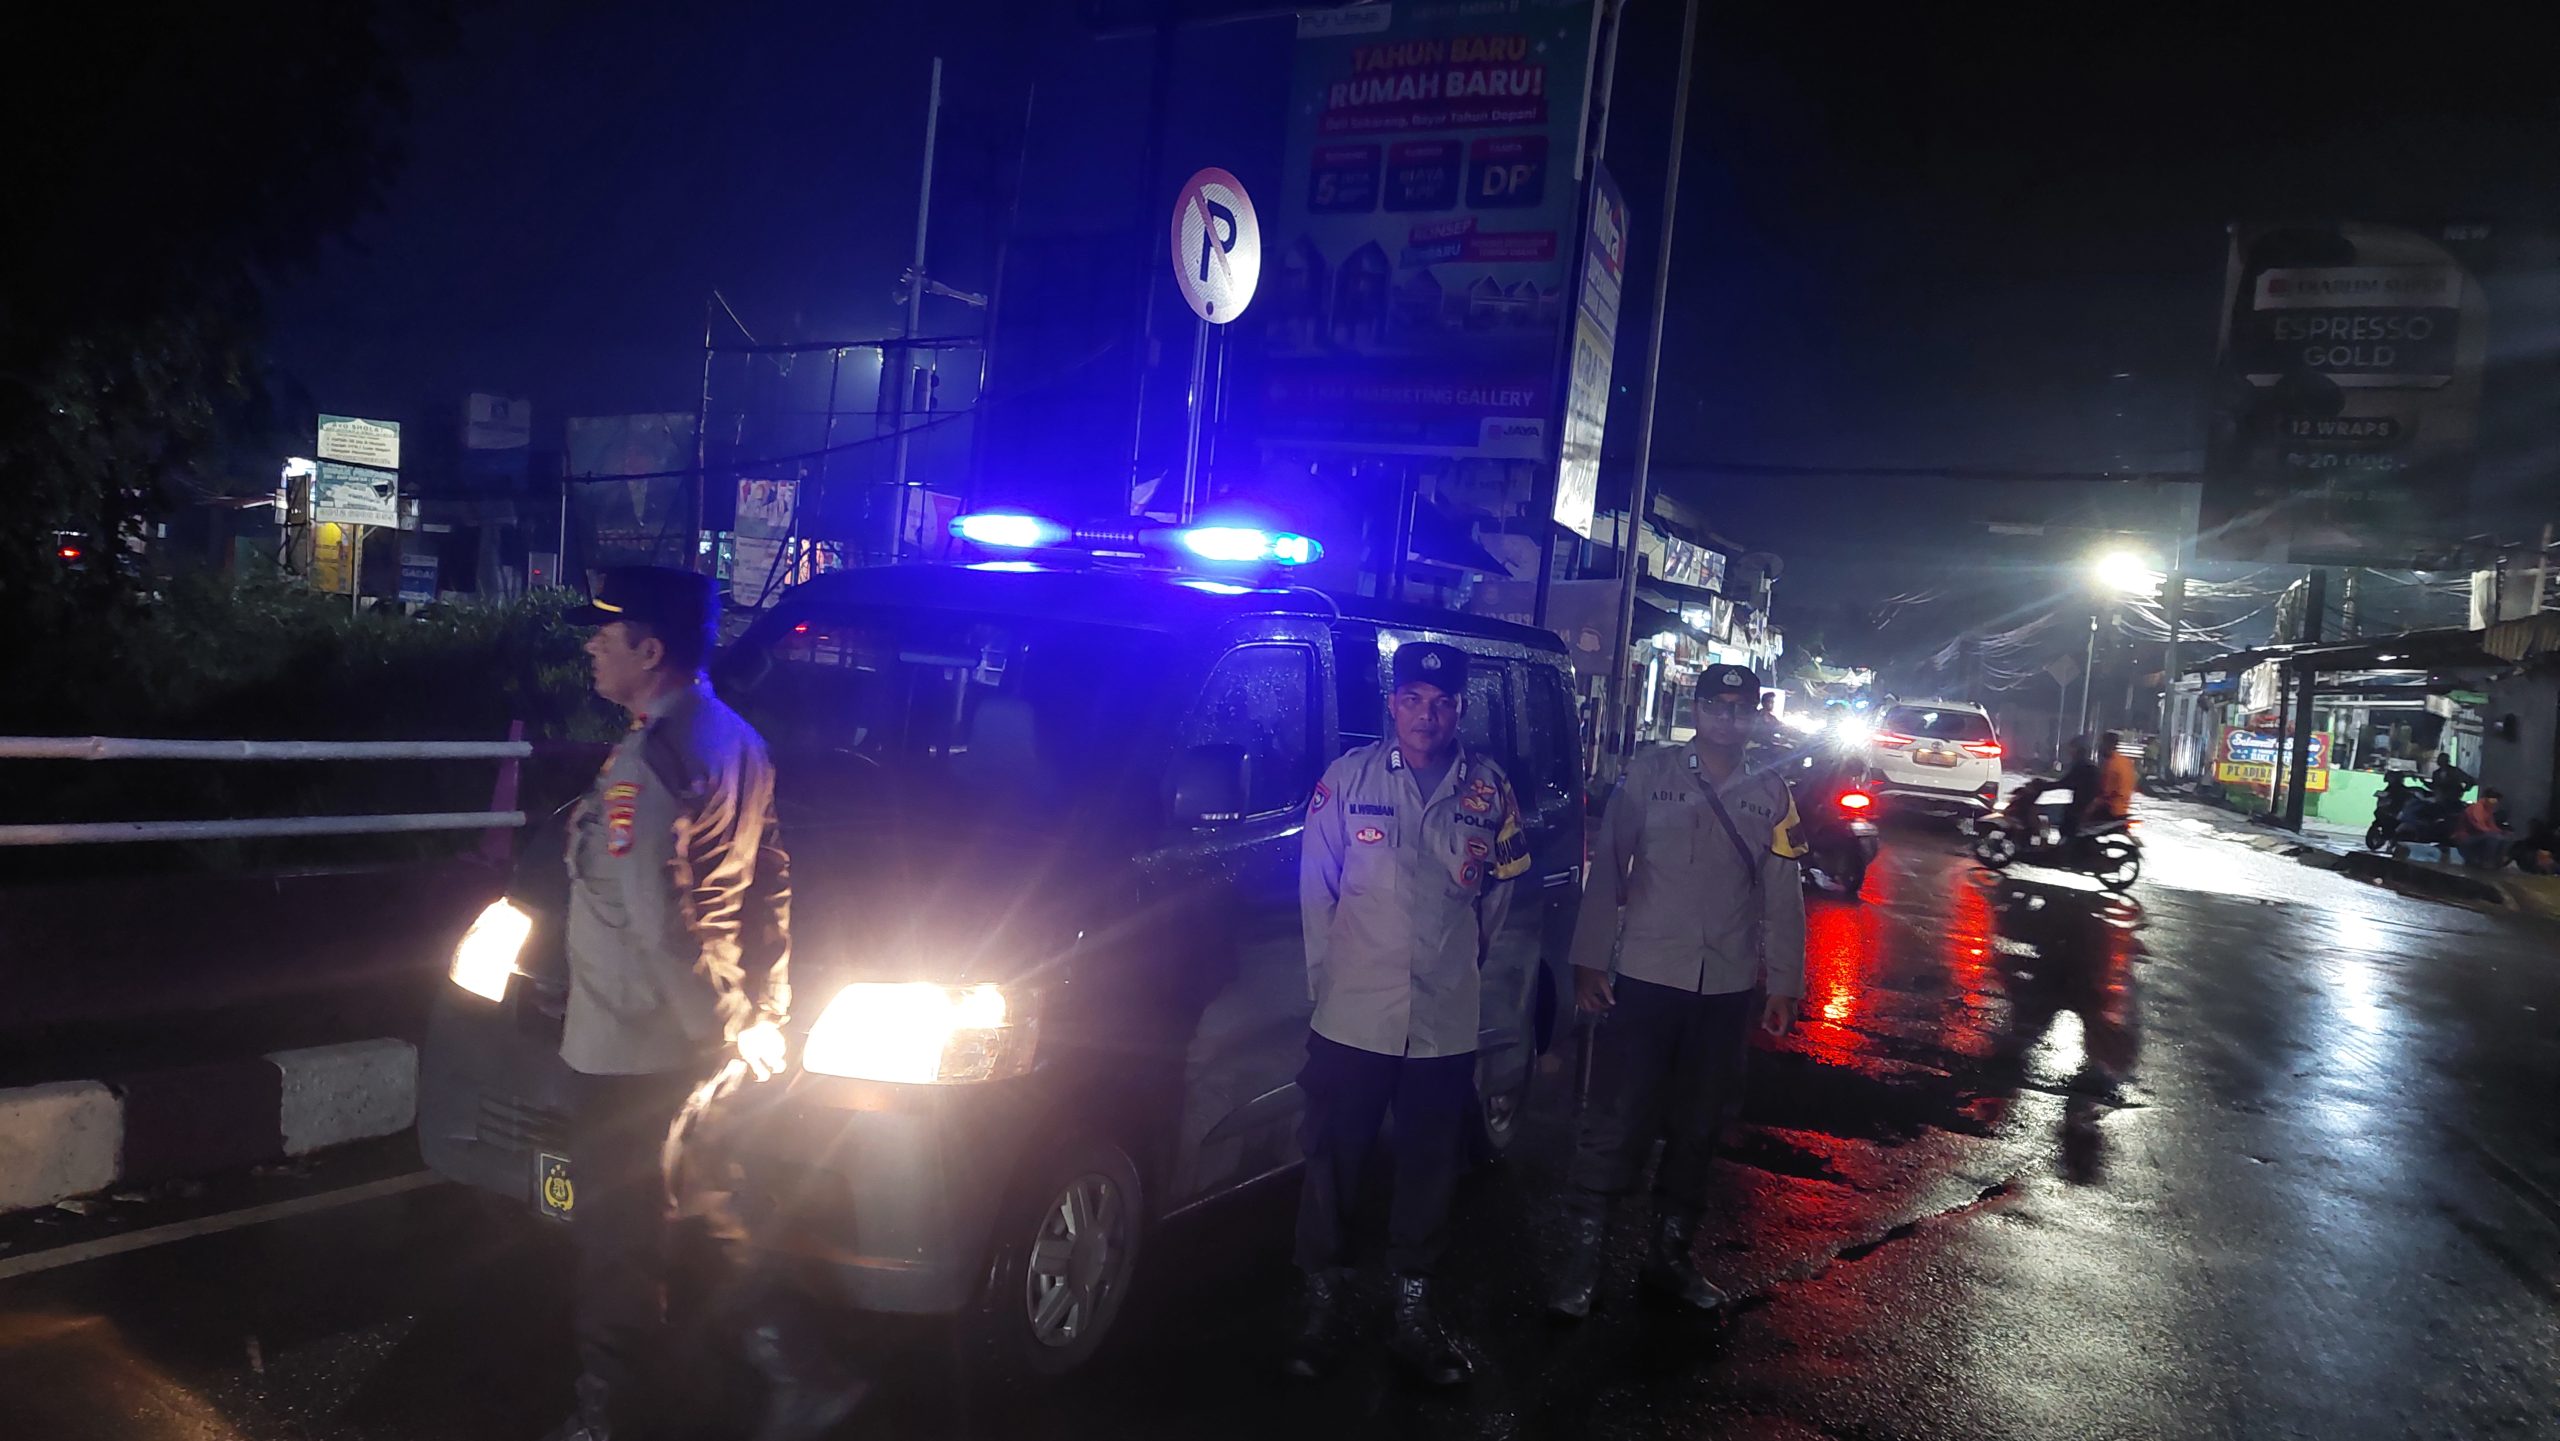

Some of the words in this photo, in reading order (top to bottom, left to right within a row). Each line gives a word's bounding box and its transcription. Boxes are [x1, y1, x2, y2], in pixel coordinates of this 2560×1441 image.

[1354, 41, 1443, 71] TAHUN
[1450, 36, 1527, 63] BARU
[1329, 72, 1439, 109] RUMAH
[1446, 67, 1543, 97] BARU!
[1200, 199, 1237, 282] P
[2274, 316, 2434, 341] ESPRESSO
[2304, 345, 2396, 367] GOLD
[1456, 388, 1534, 408] GALLERY
[1503, 425, 1540, 438] JAYA
[2292, 419, 2310, 435] 12
[2317, 421, 2391, 437] WRAPS
